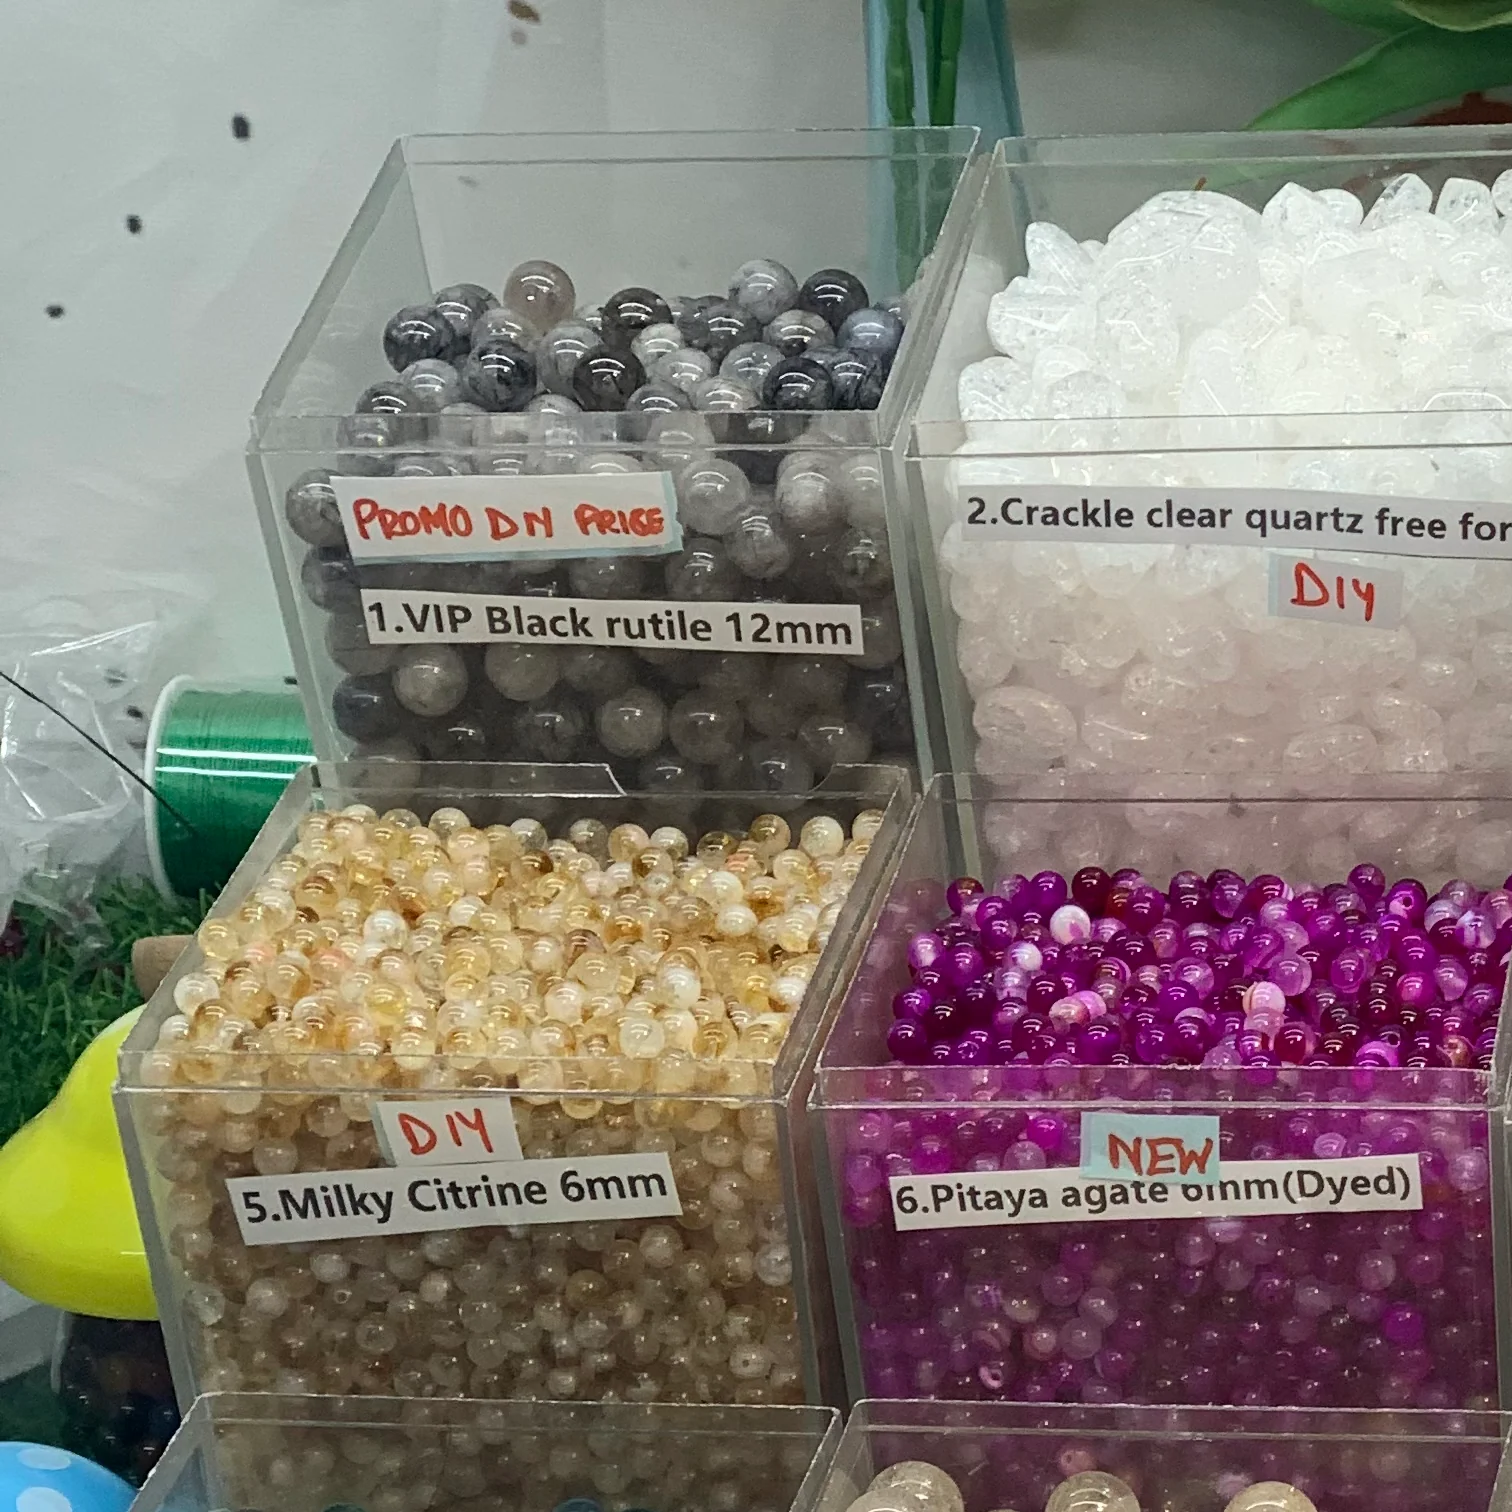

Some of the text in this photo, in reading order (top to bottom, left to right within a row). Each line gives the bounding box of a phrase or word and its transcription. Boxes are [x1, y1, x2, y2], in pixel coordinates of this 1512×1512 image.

[352, 497, 473, 540] PROMO
[966, 496, 1134, 530] 2.Crackle
[1146, 499, 1232, 529] clear
[1245, 502, 1364, 538] quartz
[1375, 508, 1447, 540] free
[1289, 562, 1376, 622] DIY
[367, 602, 853, 646] 1.VIP Black rutile 12mm
[398, 1107, 494, 1156] DIY
[1108, 1133, 1214, 1177] NEW
[242, 1170, 668, 1225] 5.Milky Citrine 6mm
[895, 1180, 1049, 1218] 6.Pitaya
[1061, 1176, 1170, 1214] agate
